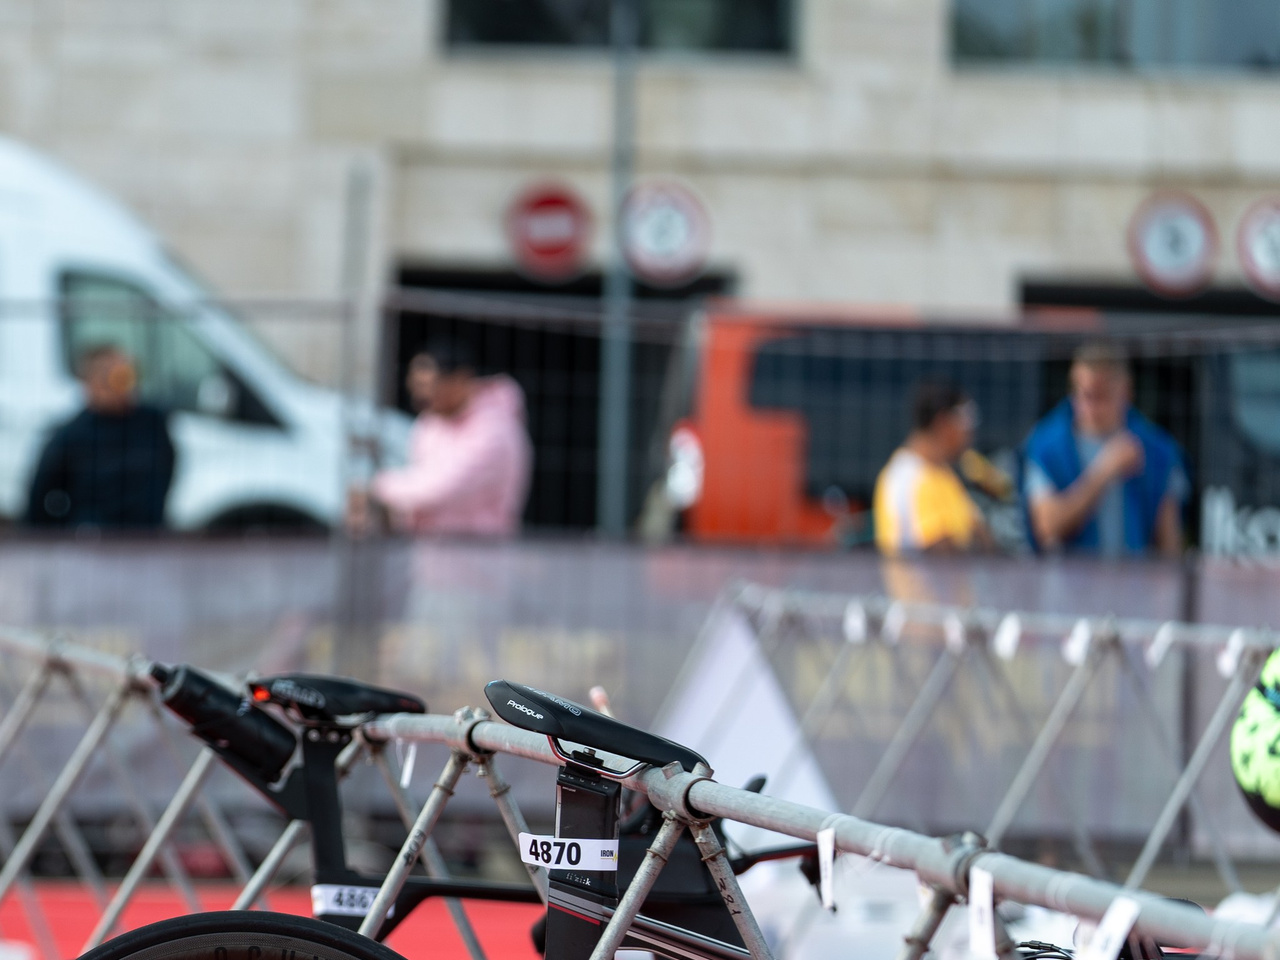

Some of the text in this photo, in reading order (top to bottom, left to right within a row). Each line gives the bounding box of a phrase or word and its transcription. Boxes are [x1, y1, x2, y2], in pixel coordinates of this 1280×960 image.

[529, 839, 614, 866] 4870 IRON
[332, 887, 380, 909] 486
